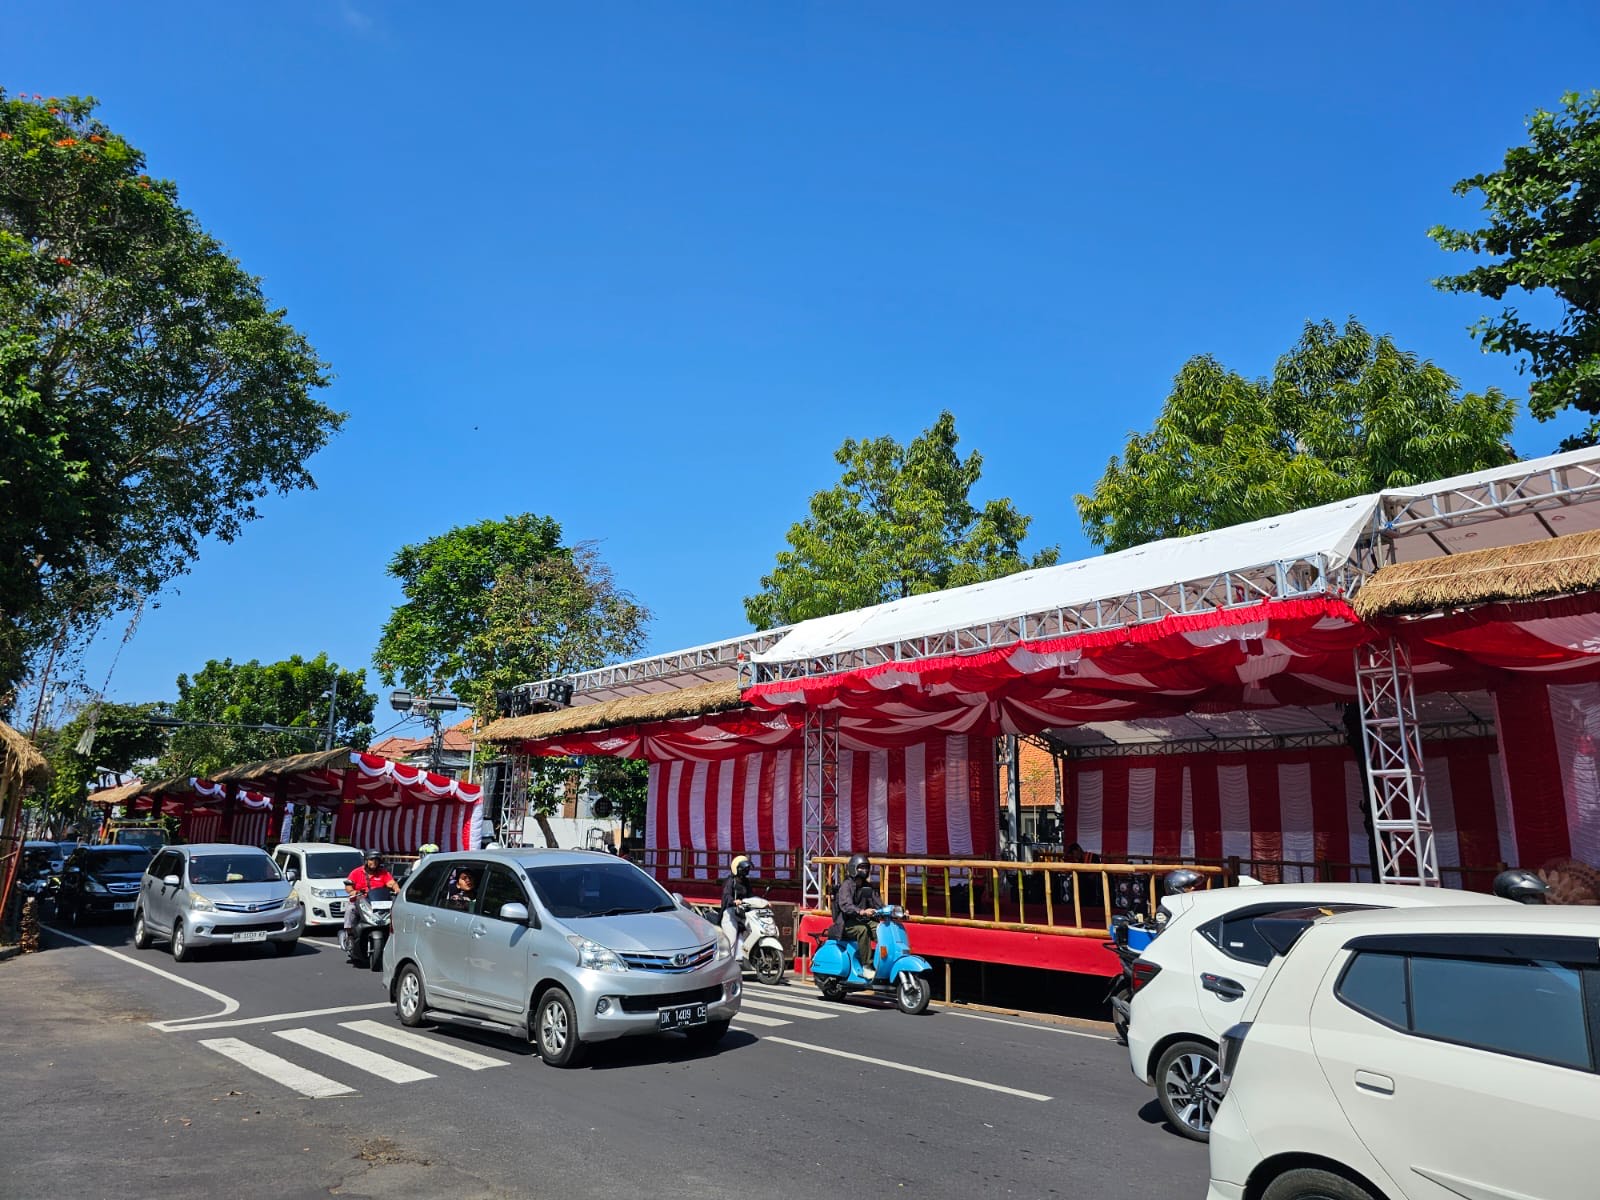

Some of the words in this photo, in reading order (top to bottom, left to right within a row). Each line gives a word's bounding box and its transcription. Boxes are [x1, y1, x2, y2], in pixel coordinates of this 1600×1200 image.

[661, 1011, 670, 1024] DK
[675, 1008, 691, 1021] 1409
[697, 1006, 706, 1017] CE
